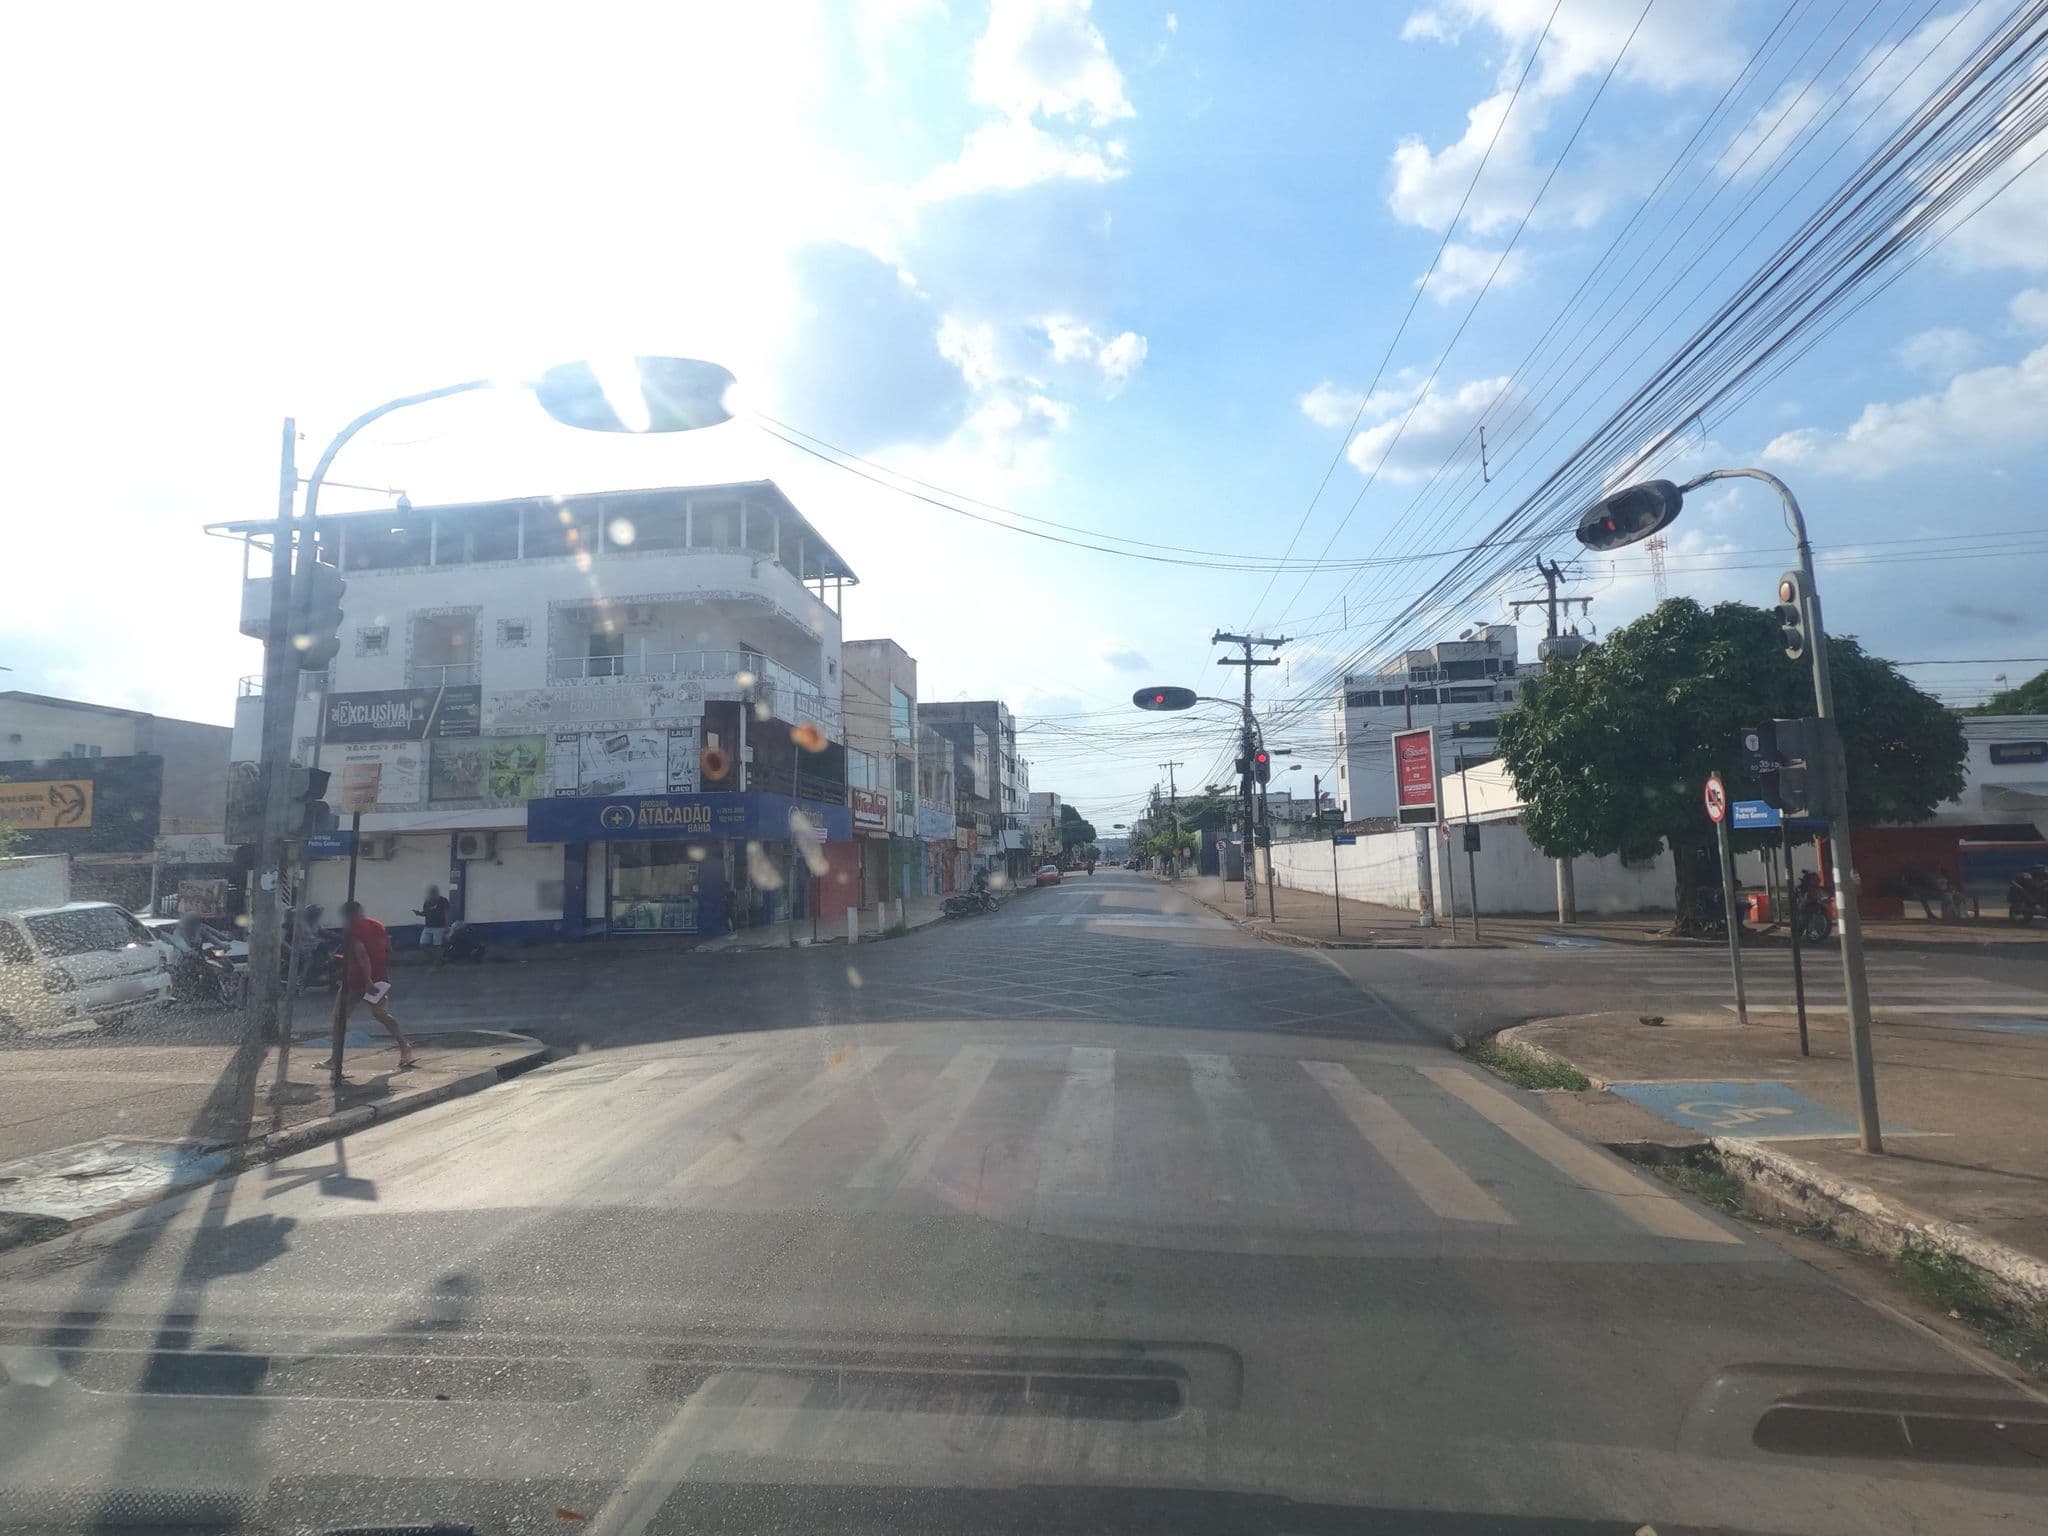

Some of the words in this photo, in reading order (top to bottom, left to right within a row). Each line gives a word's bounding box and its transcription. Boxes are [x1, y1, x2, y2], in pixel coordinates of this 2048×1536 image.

[339, 700, 407, 724] EXCLUSIVA
[638, 803, 712, 825] ATACADÃO
[688, 823, 711, 833] BAHIA
